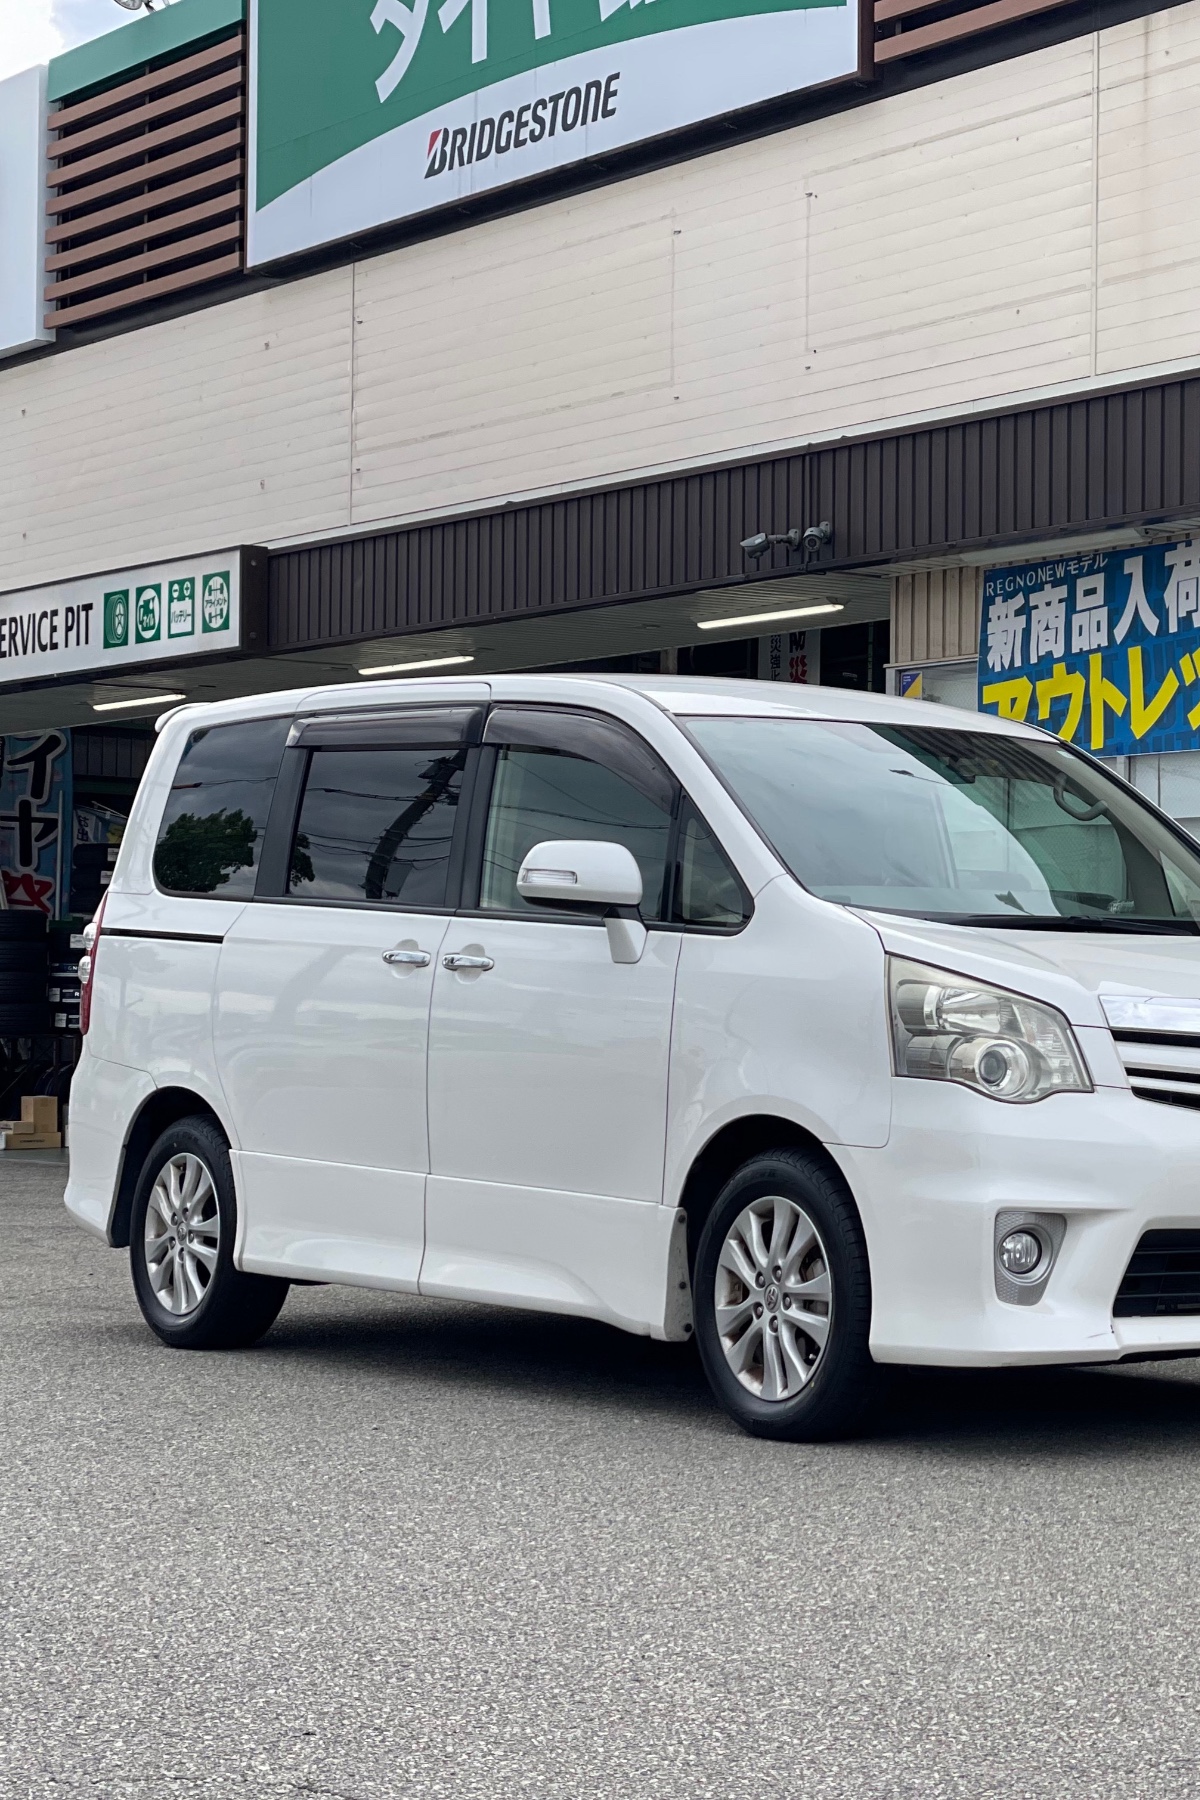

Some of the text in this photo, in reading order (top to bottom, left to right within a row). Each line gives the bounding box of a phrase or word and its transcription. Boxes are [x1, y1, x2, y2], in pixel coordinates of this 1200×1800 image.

[424, 72, 620, 179] BRIDGESTONE
[205, 594, 228, 609] アライメント
[142, 615, 155, 627] オイル
[170, 609, 192, 624] バッテリー
[64, 602, 93, 648] PIT
